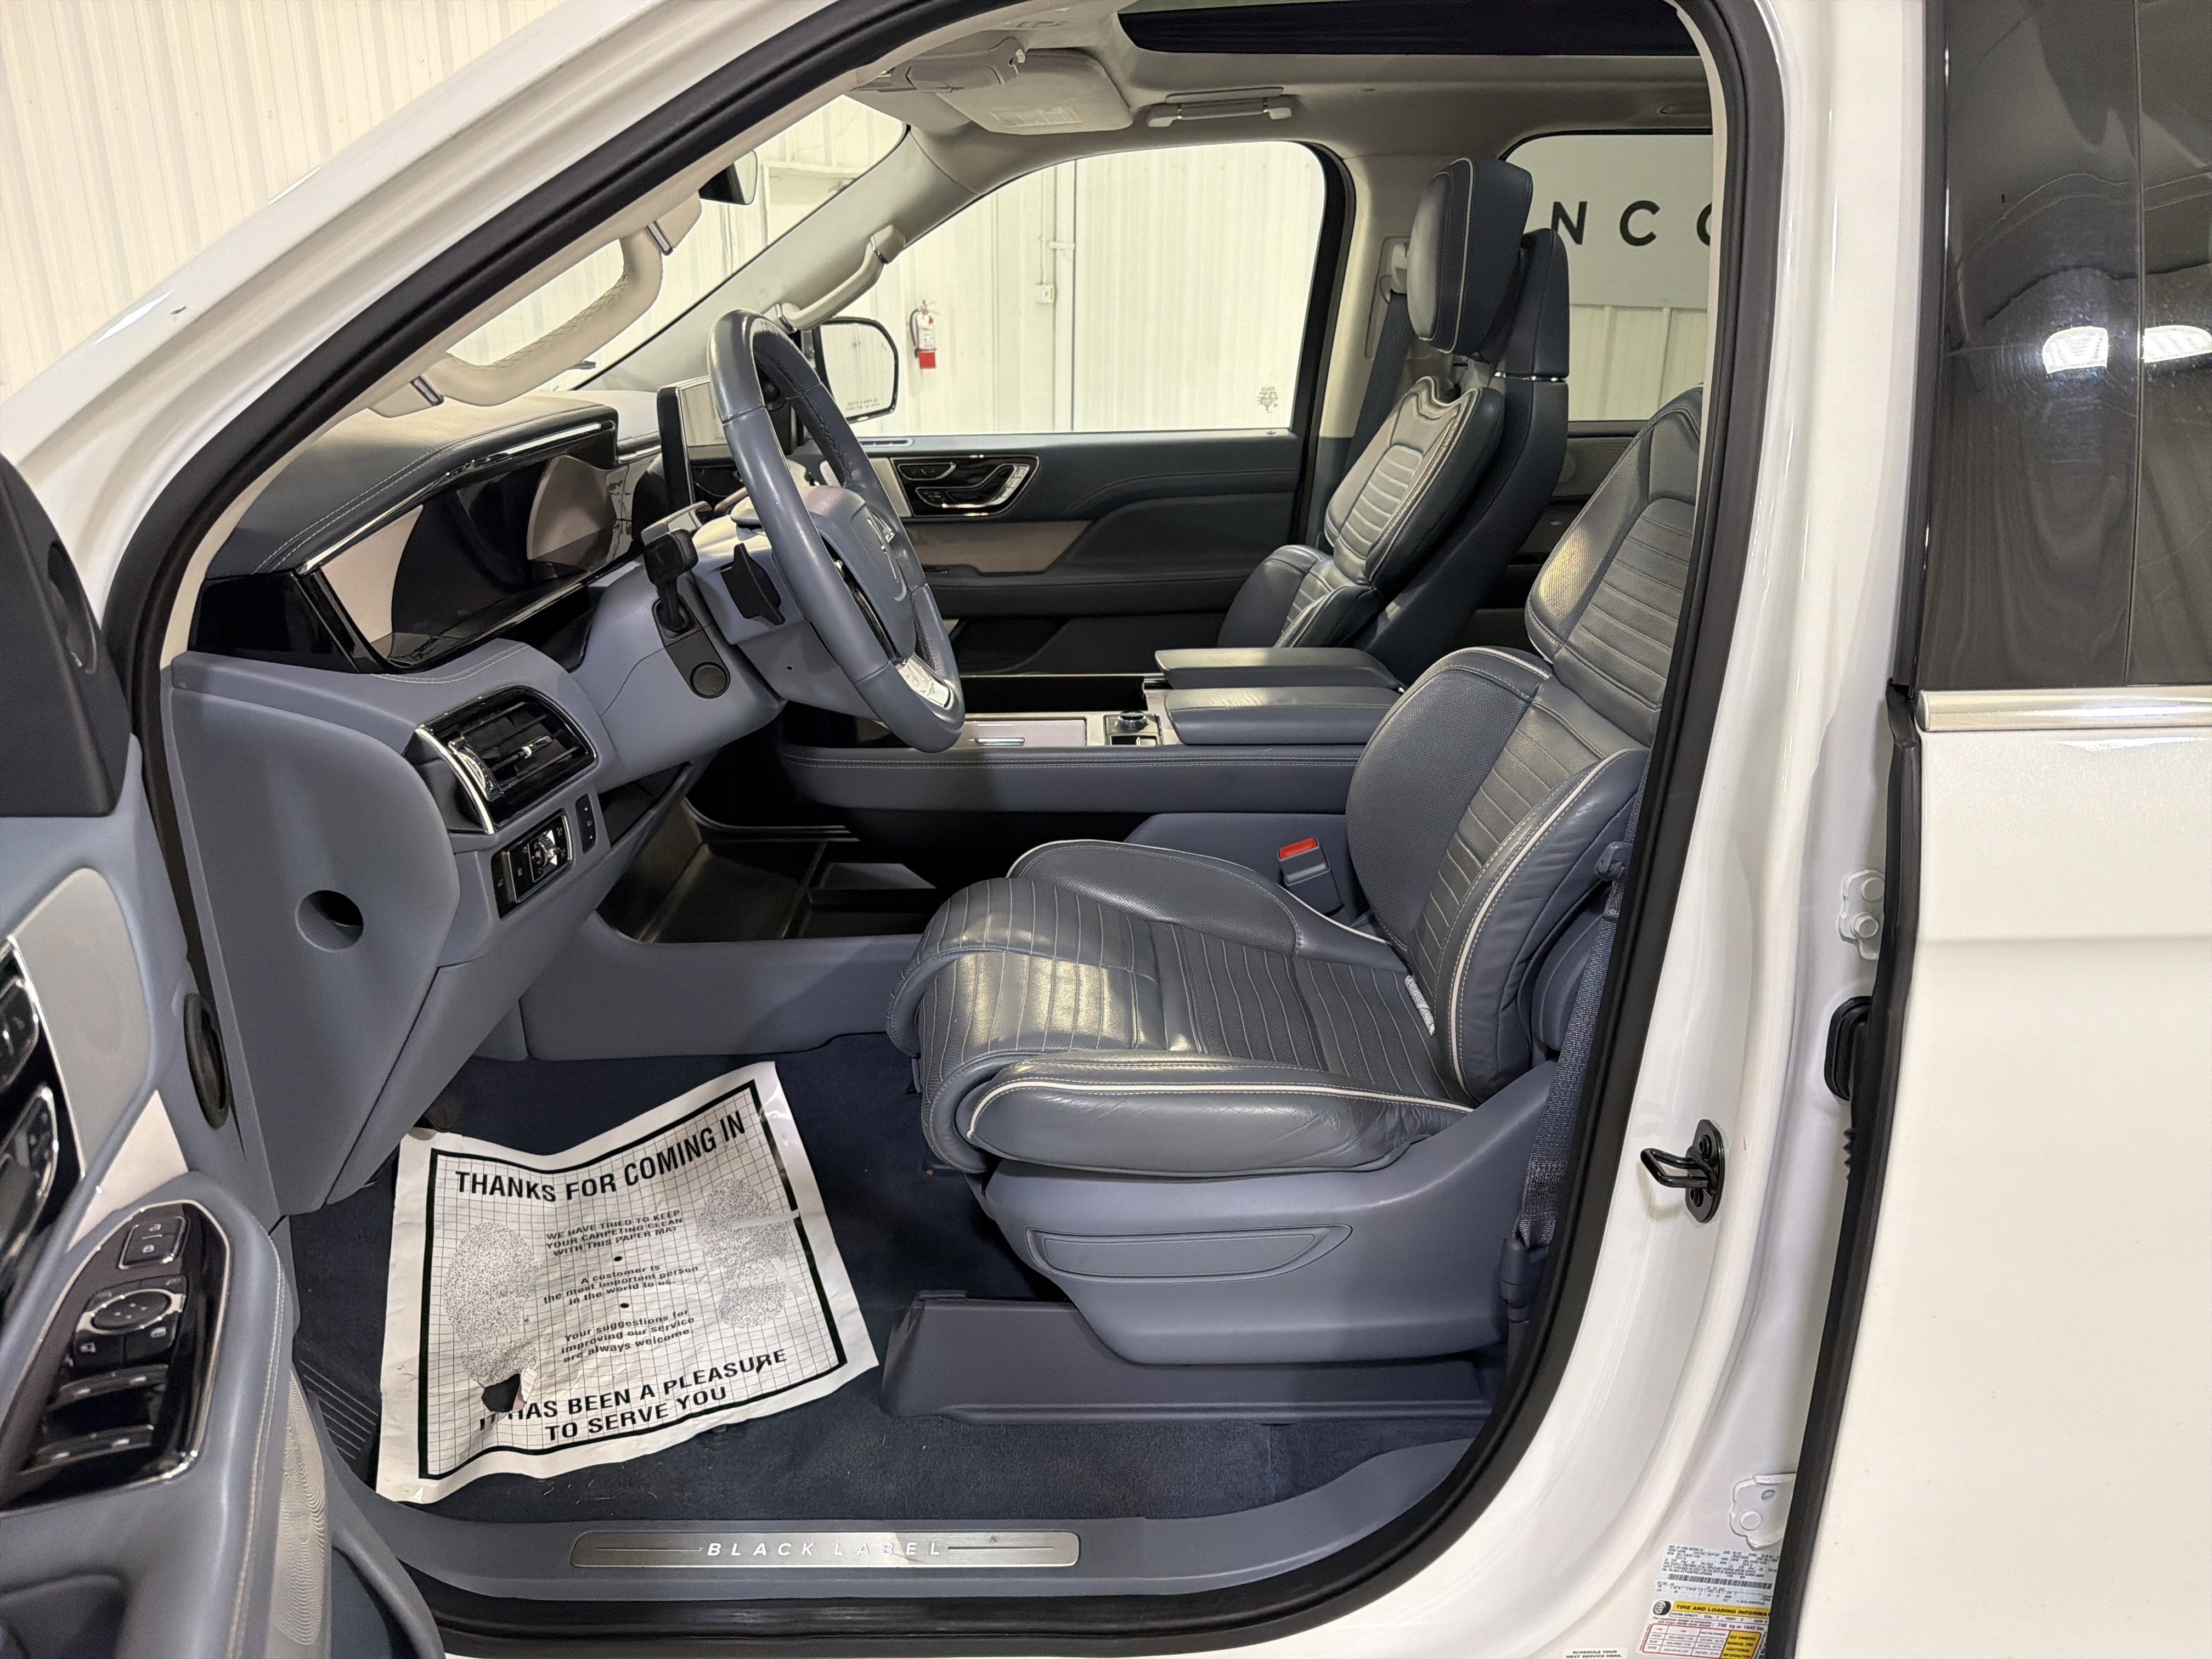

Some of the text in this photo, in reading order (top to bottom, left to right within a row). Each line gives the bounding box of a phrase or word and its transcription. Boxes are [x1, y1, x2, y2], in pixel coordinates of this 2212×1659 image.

[1550, 200, 1712, 247] NC
[455, 1110, 746, 1202] THANKS FOR COMING IN
[546, 1232, 564, 1240] WE
[568, 1224, 596, 1236] HAVE
[599, 1219, 631, 1229] TRIED
[653, 1209, 680, 1221] KEEP
[546, 1218, 682, 1249] YOUR CARPETING CLEAN
[554, 1226, 678, 1256] WITH THIS PAPER MAT
[544, 1266, 698, 1304] the most important person
[584, 1290, 602, 1300] the
[605, 1283, 639, 1294] world
[592, 1267, 646, 1282] customer
[561, 1330, 623, 1354] improving
[651, 1317, 695, 1333] service
[565, 1309, 689, 1342] Your suggestions for
[563, 1328, 694, 1363] are always welcome.
[568, 1388, 630, 1415] BEEN
[639, 1384, 656, 1401] A
[663, 1349, 787, 1395] PLEASURE
[545, 1386, 727, 1441] TO SERVE YOU
[707, 1542, 940, 1556] BLACK LABEL
